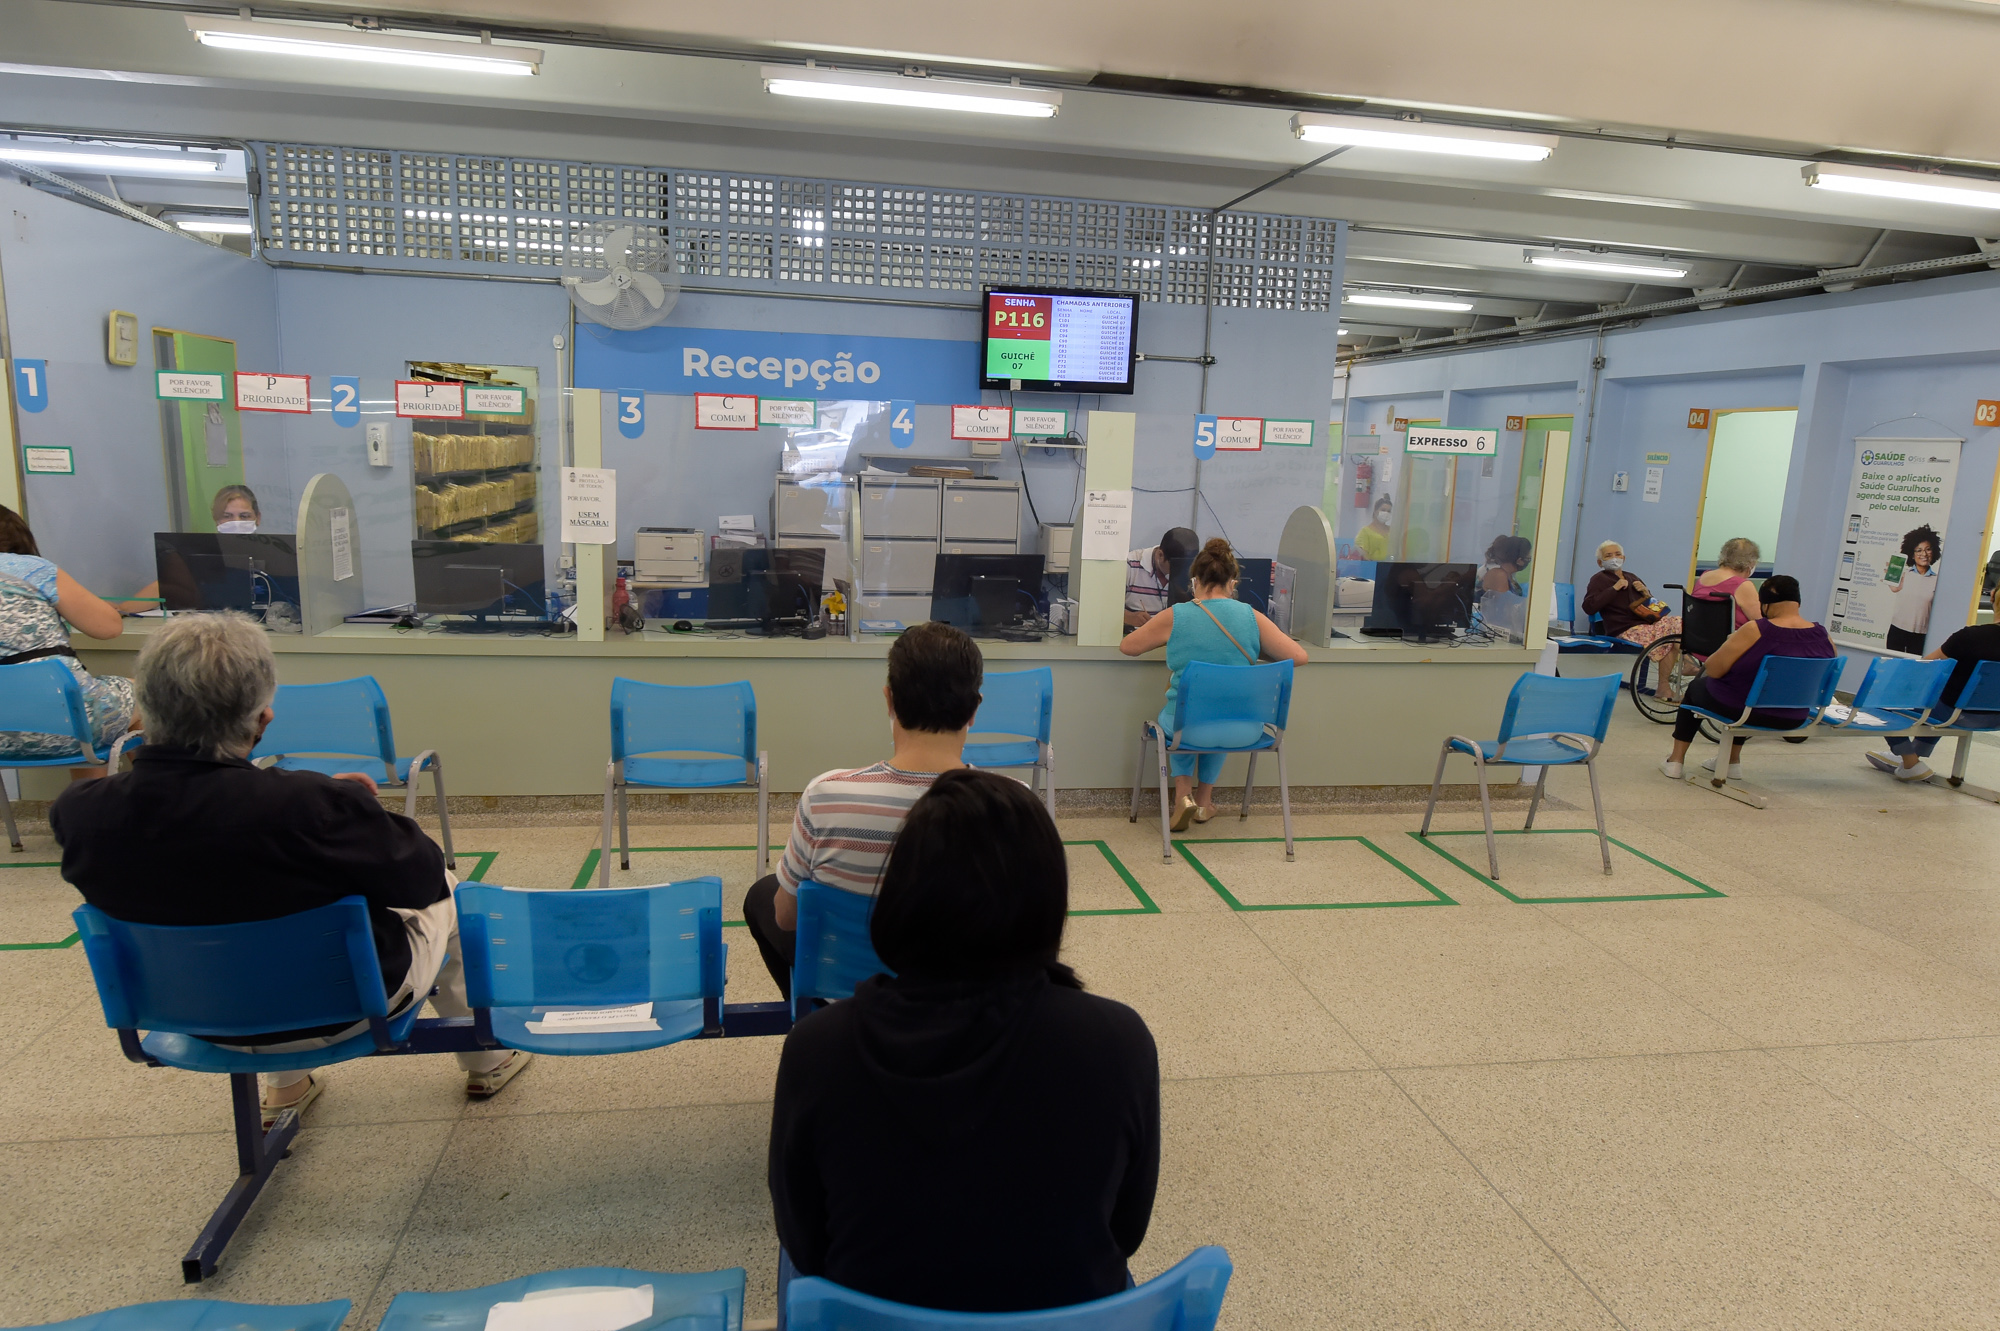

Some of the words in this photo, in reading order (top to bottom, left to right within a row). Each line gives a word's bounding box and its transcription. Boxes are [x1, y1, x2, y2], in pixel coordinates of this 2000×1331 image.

[1005, 298, 1036, 307] SENHA
[994, 311, 1045, 328] P116
[1001, 352, 1035, 361] GUICHÊ
[683, 347, 880, 390] Recepção
[21, 367, 38, 397] 1
[186, 380, 213, 388] FAVOR,
[267, 377, 276, 390] P
[172, 386, 210, 394] SILÊNCIO!
[425, 385, 434, 397] P
[243, 394, 305, 405] PRIORIDADE
[333, 384, 357, 412] 2
[723, 397, 734, 410] C
[403, 403, 460, 411] PRIORIDADE
[620, 397, 641, 424] 3
[1977, 404, 1997, 422] 03
[711, 414, 746, 422] COMUM
[978, 409, 988, 421] C
[1690, 412, 1704, 425] 04
[892, 409, 913, 434] 4
[1232, 420, 1241, 432] C
[1395, 420, 1405, 429] 06
[1508, 419, 1520, 429] 05
[966, 425, 999, 433] COMUM
[1196, 422, 1214, 446] 5
[1410, 437, 1468, 448] EXPRESSO
[1477, 437, 1485, 450] 6
[1875, 451, 1905, 461] SAÚDE
[1862, 472, 1885, 480] Baixe
[1896, 474, 1942, 483] aplicativo
[1860, 482, 1885, 490] Saúde
[1888, 484, 1931, 493] Guarulhos
[1856, 492, 1885, 500] agende
[1902, 495, 1940, 504] consulta
[1869, 503, 1887, 511] pelo
[1889, 504, 1920, 512] celular.
[570, 519, 609, 527] MÁSCARA!
[1842, 626, 1861, 634] Baixe
[1862, 630, 1885, 639] agora!
